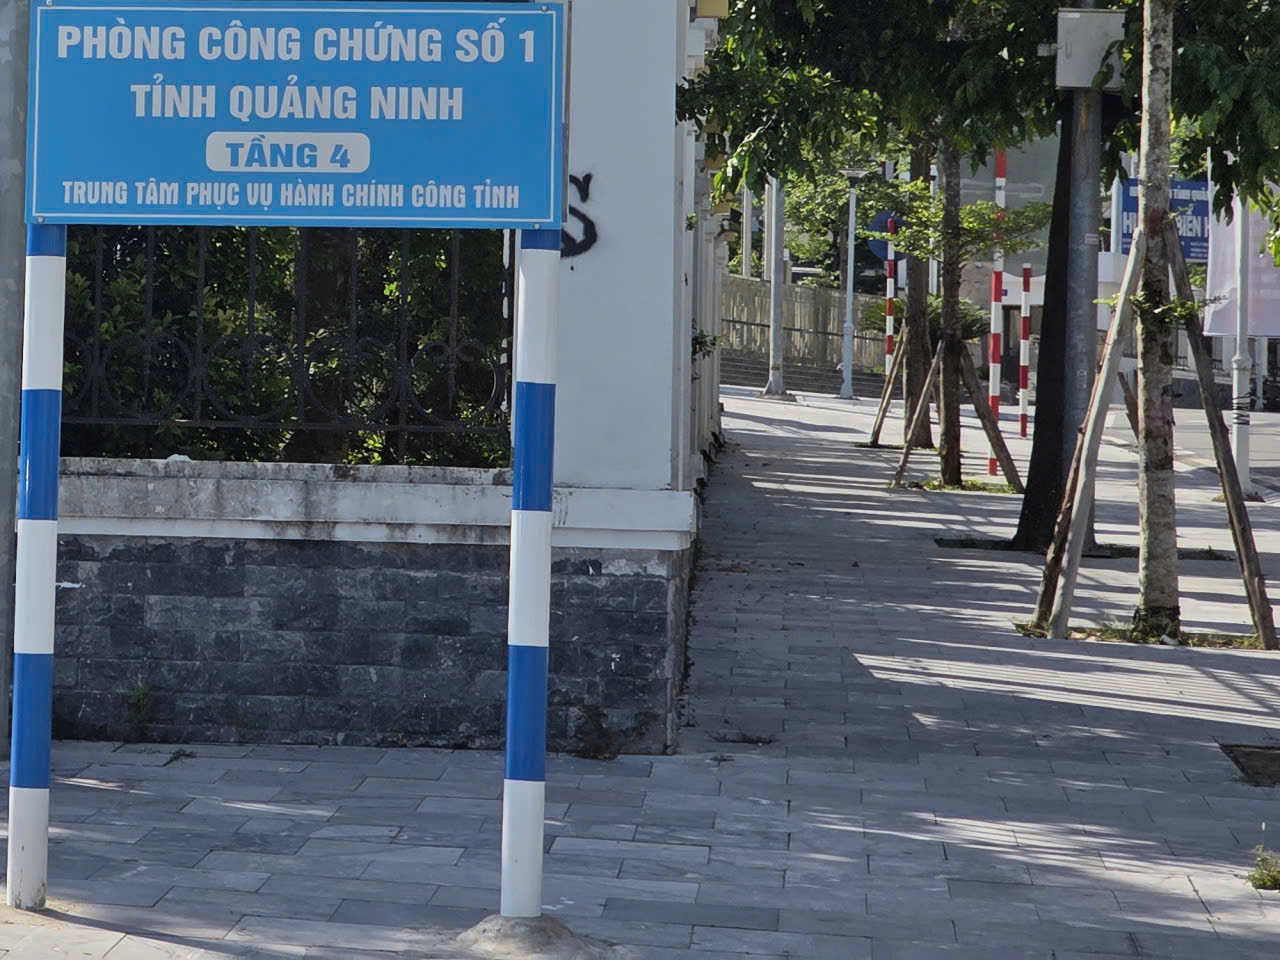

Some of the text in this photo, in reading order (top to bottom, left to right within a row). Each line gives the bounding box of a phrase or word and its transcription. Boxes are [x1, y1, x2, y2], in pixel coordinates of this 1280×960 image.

[58, 18, 534, 62] PHÒNG CÔNG CHỨNG SỐ 1
[131, 74, 462, 121] TỈNH QUẢNG NINH
[226, 135, 350, 168] TẦNG 4
[63, 178, 518, 211] TRUNG TÂM PHỤC VỤ HÀNH CHÍNH CÔNG TỈNH
